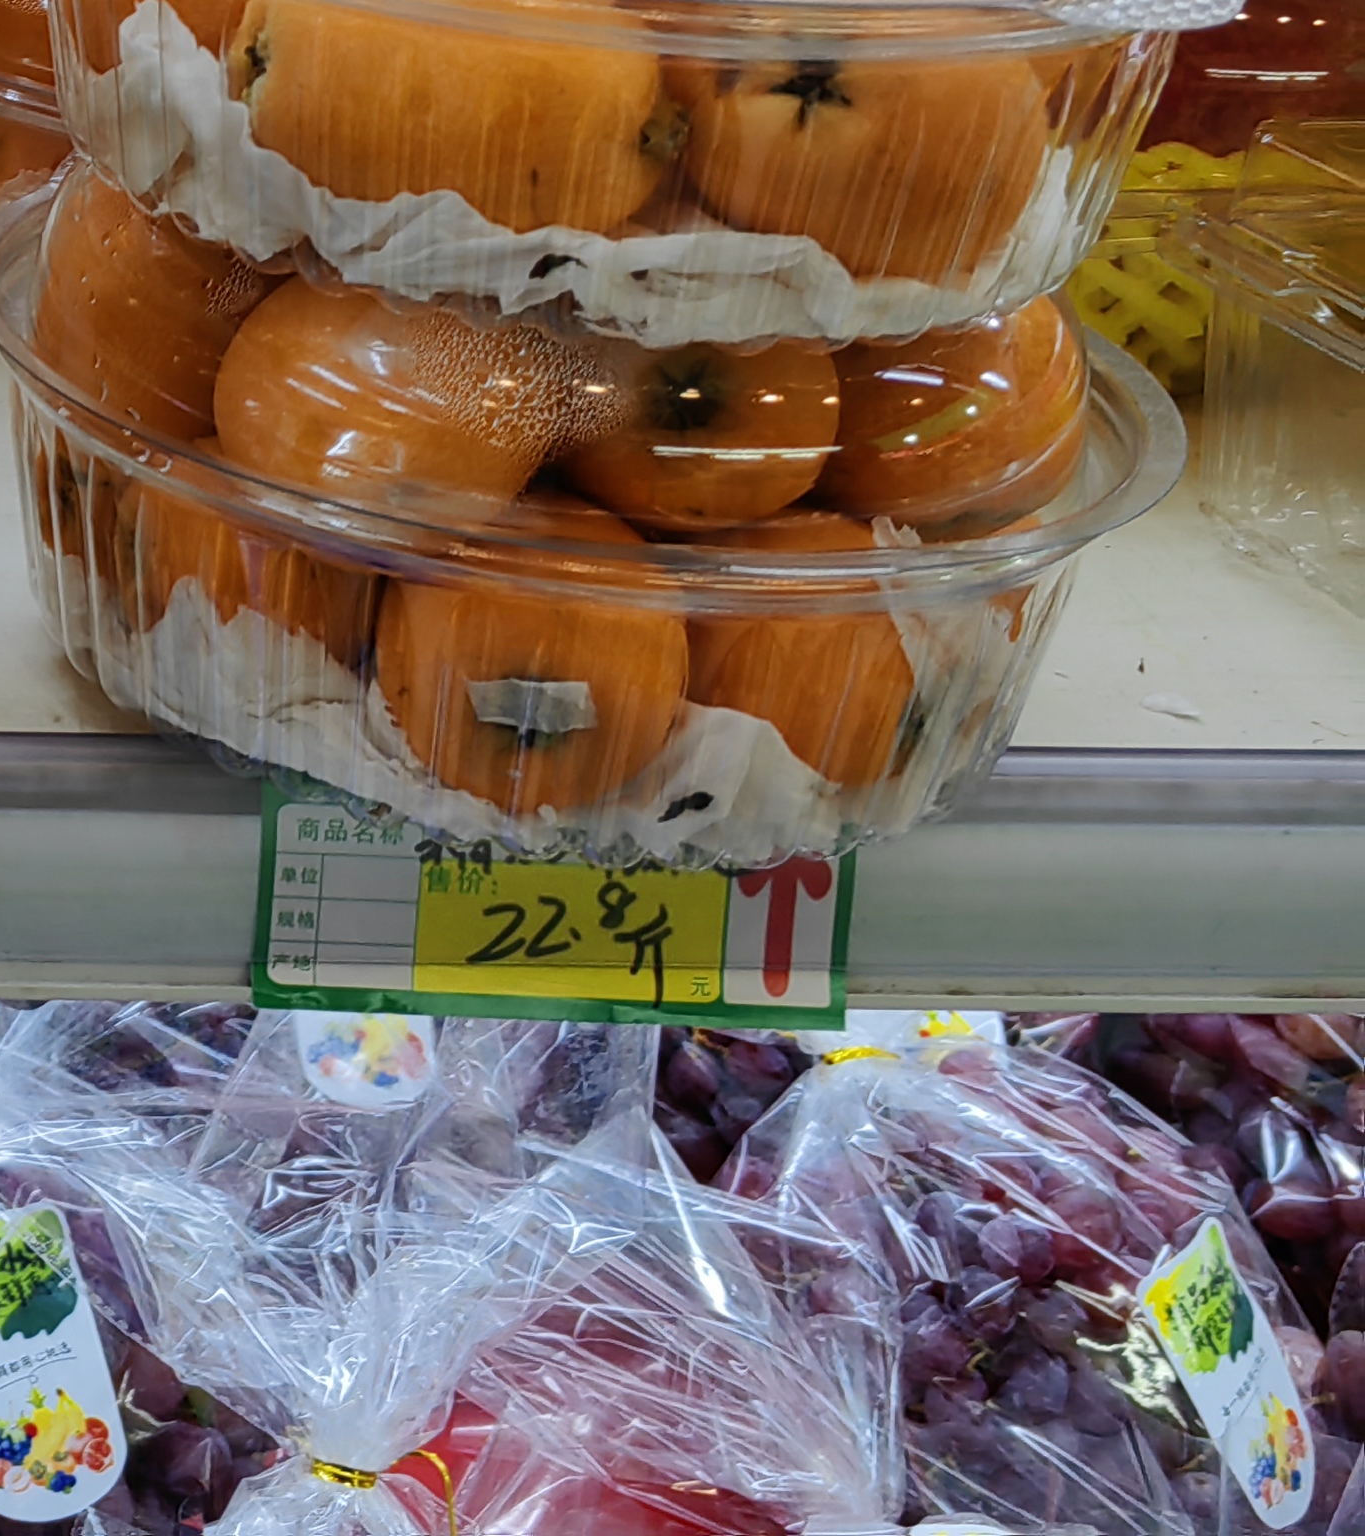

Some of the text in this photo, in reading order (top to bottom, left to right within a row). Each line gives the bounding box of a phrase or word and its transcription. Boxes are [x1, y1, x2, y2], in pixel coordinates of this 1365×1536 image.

[280, 866, 318, 885] 单位
[277, 910, 315, 929] 规格
[272, 953, 314, 972] 产地
[690, 976, 712, 997] 元
